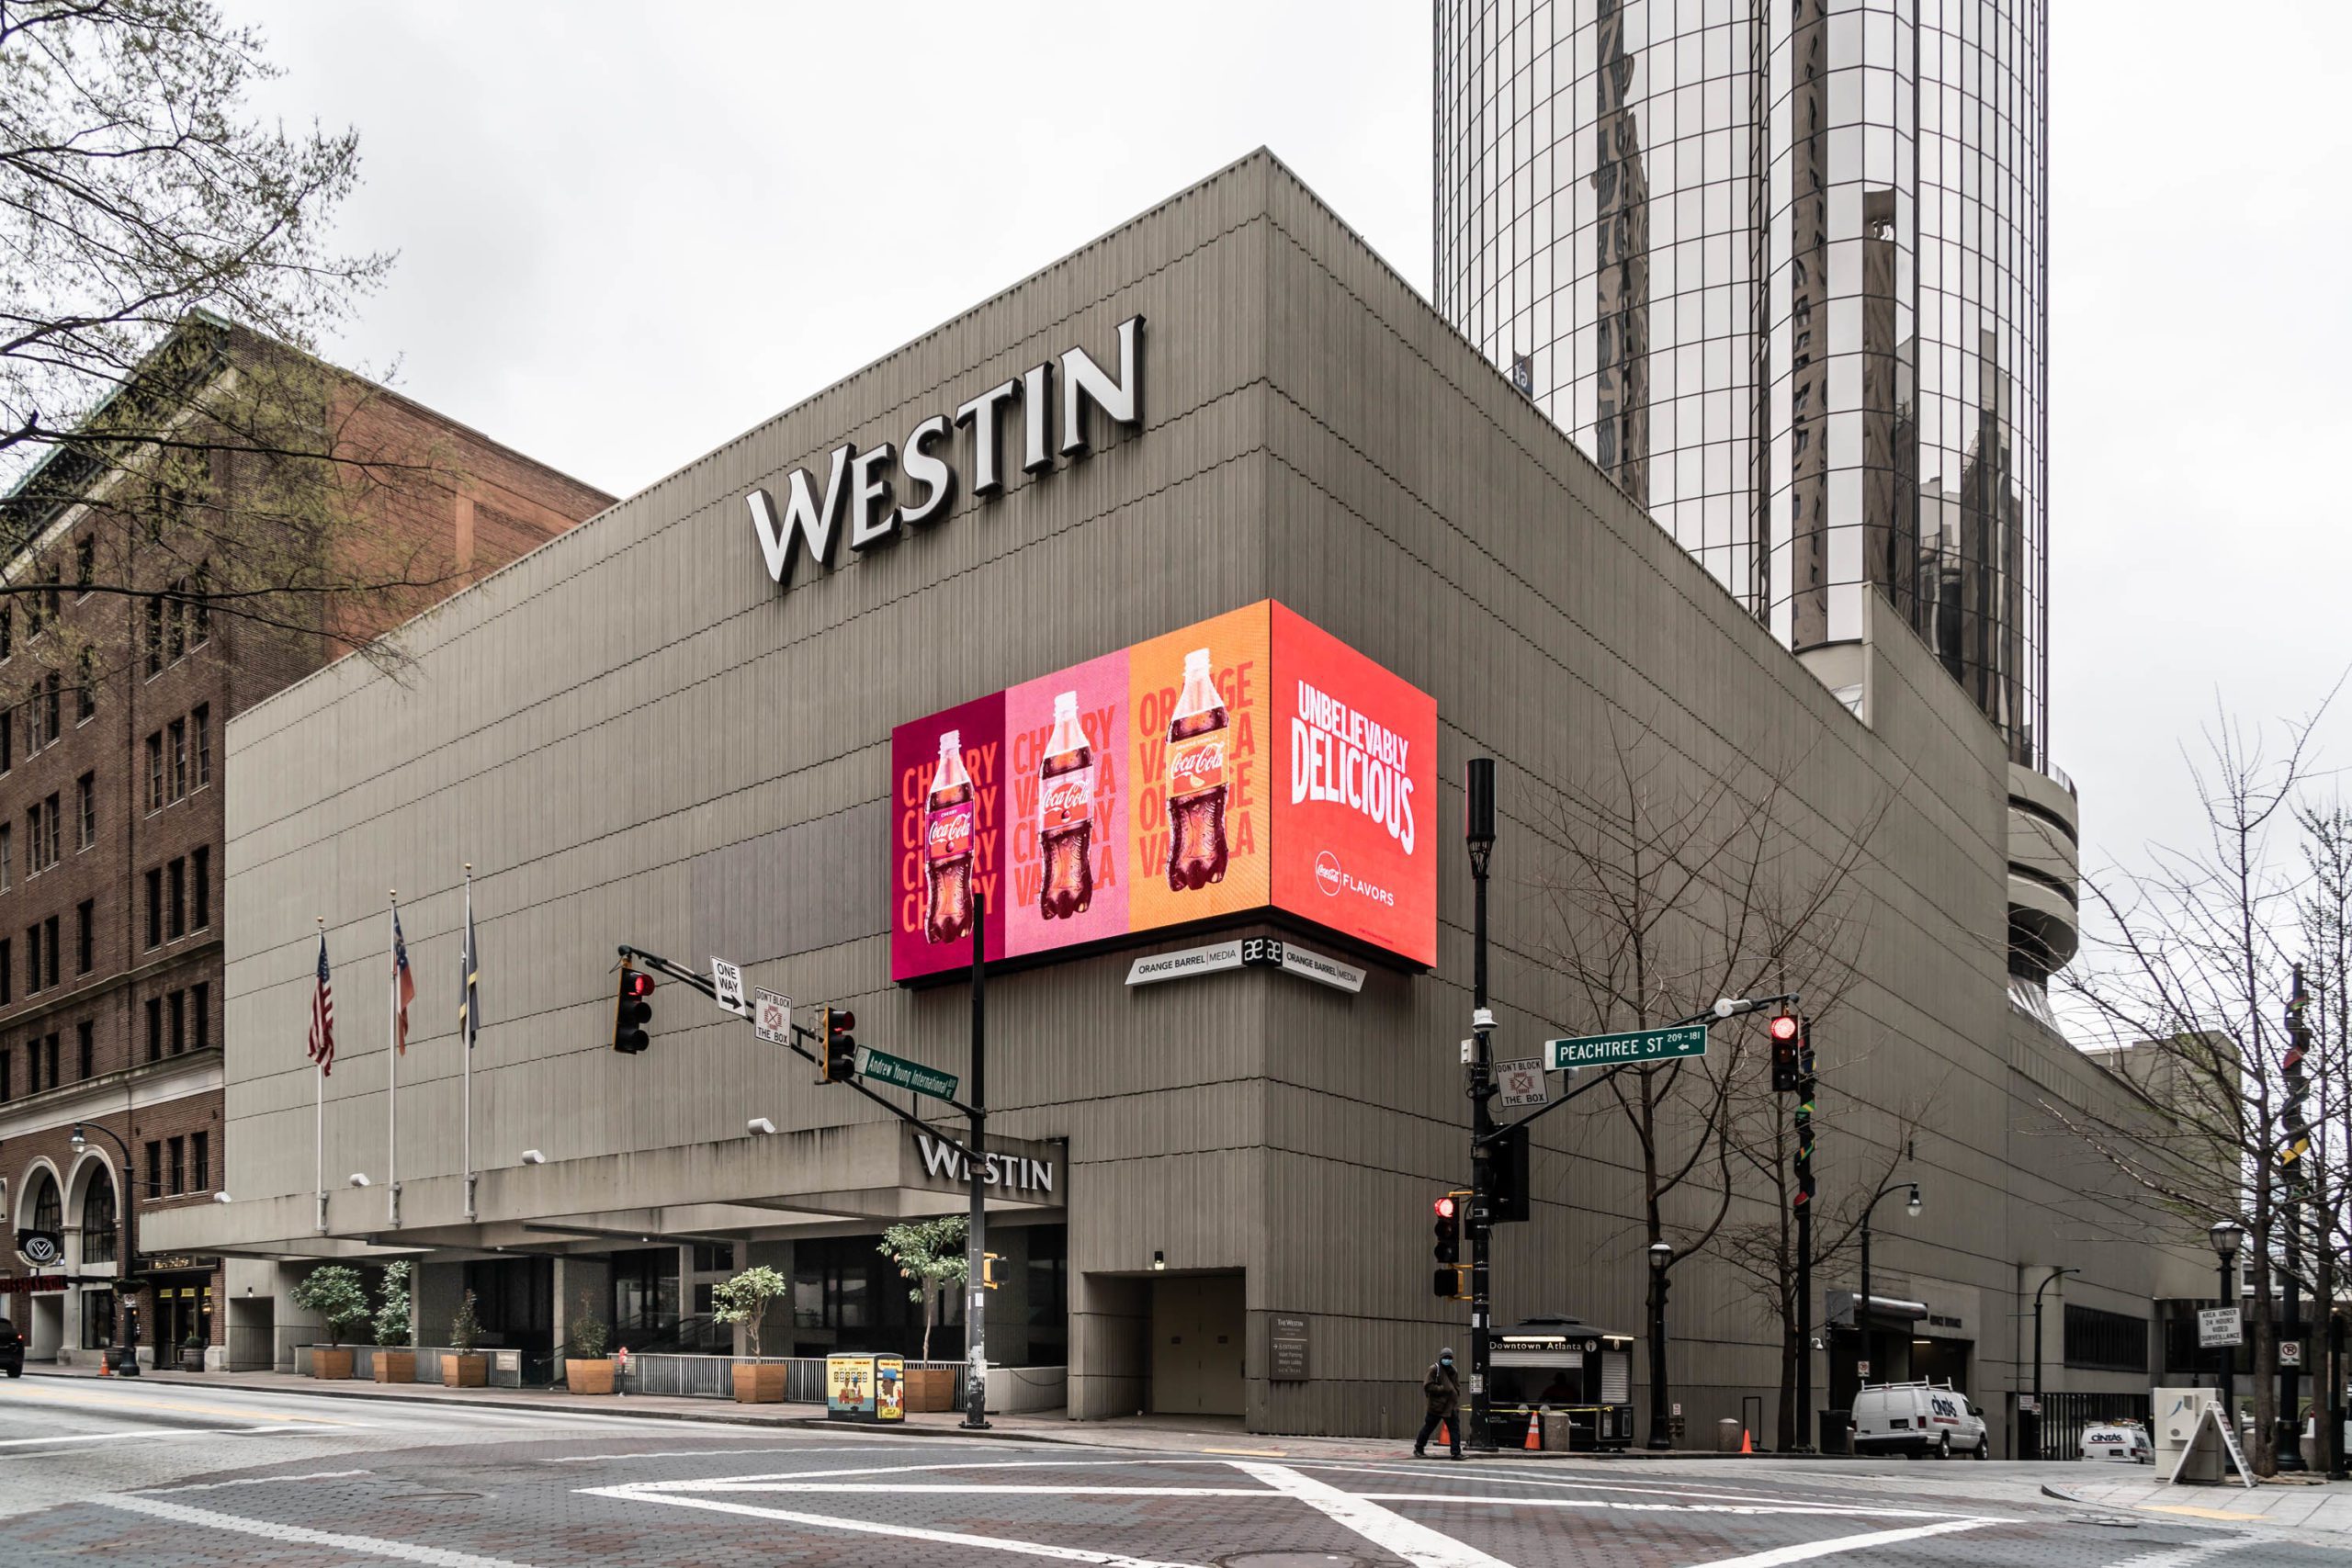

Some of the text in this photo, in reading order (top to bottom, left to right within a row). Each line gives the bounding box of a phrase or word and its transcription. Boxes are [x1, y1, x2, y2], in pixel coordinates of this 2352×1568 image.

[745, 314, 1146, 585] WESTIN
[1140, 661, 1253, 737] ORGE
[1014, 705, 1115, 774] CHRY
[1298, 680, 1408, 773] UNBELIEVABLY
[903, 741, 997, 807] CHRY
[1292, 716, 1414, 855] DELICIOUS
[929, 812, 970, 845] Coca-Cola
[1343, 874, 1394, 906] FLAVORS
[717, 963, 737, 979] ONE
[1139, 949, 1237, 975] ORANGE BARREL MEDIA
[1286, 952, 1358, 983] ORANGE BARREL MEDIA
[718, 976, 738, 993] WAY
[756, 990, 790, 1009] DON'T BLOCK
[758, 1027, 788, 1043] THE BOX
[1560, 1039, 1639, 1062] PEACHTREE
[1646, 1037, 1664, 1053] ST
[868, 1055, 892, 1077] Andrew
[893, 1063, 912, 1087] Young
[910, 1069, 949, 1094] International
[1497, 1060, 1542, 1074] DON'T BLOCK
[1505, 1093, 1544, 1105] THE BOX
[2219, 1309, 2237, 1317] UNDER
[1489, 1341, 1581, 1350] Downtown Atlanta
[2201, 1332, 2241, 1341] SURVEILLANCE
